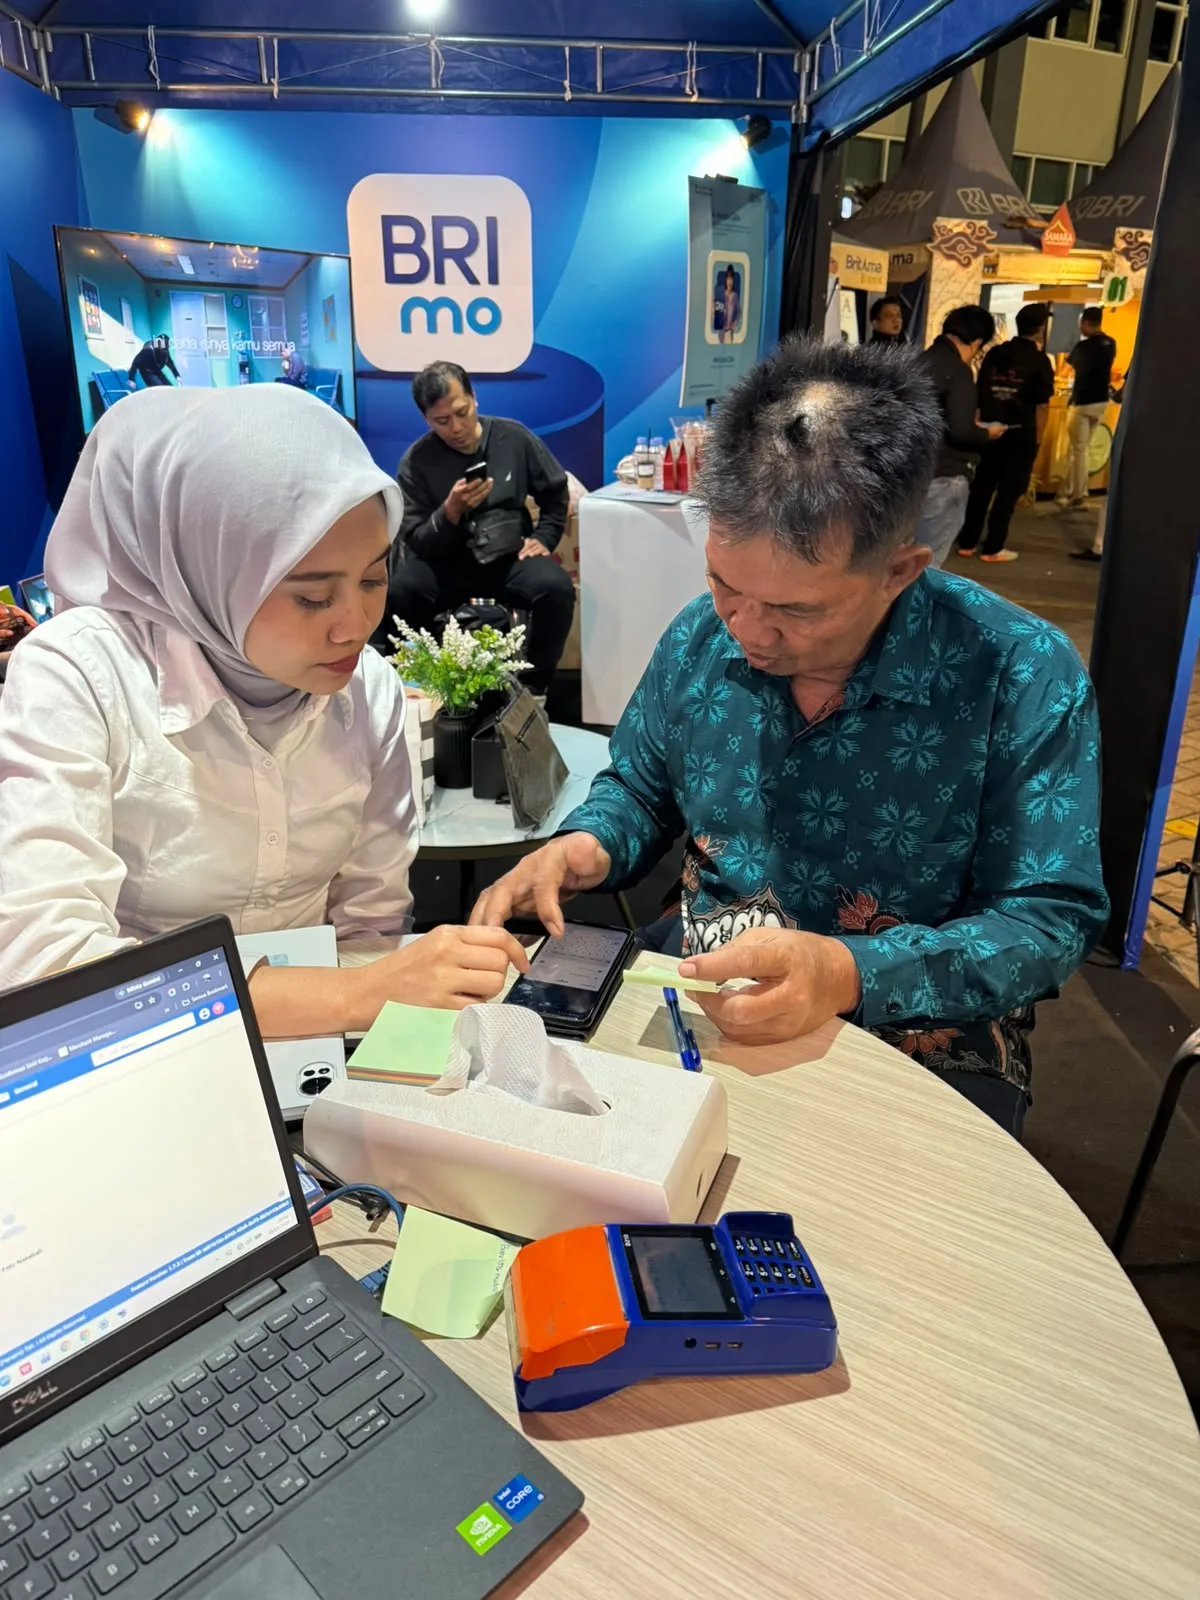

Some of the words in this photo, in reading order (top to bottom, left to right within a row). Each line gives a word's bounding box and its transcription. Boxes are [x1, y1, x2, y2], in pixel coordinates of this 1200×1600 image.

[990, 193, 1036, 217] BRI
[1087, 195, 1146, 219] BRI
[381, 214, 499, 286] BRI
[1107, 275, 1128, 303] 01
[400, 296, 502, 335] mo
[262, 340, 296, 352] semua
[304, 1312, 330, 1331] backspace
[375, 1369, 389, 1381] shift
[11, 1380, 59, 1415] DELL
[232, 1402, 240, 1412] P
[165, 1419, 174, 1428] 9
[225, 1444, 234, 1453] L
[122, 1474, 133, 1486] U
[187, 1468, 199, 1479] K
[153, 1493, 160, 1505] J
[82, 1501, 92, 1512] Y
[185, 1504, 200, 1517] M
[109, 1520, 122, 1533] H
[41, 1528, 51, 1540] T
[147, 1533, 161, 1547] N
[68, 1549, 80, 1562] G
[106, 1563, 119, 1576] B
